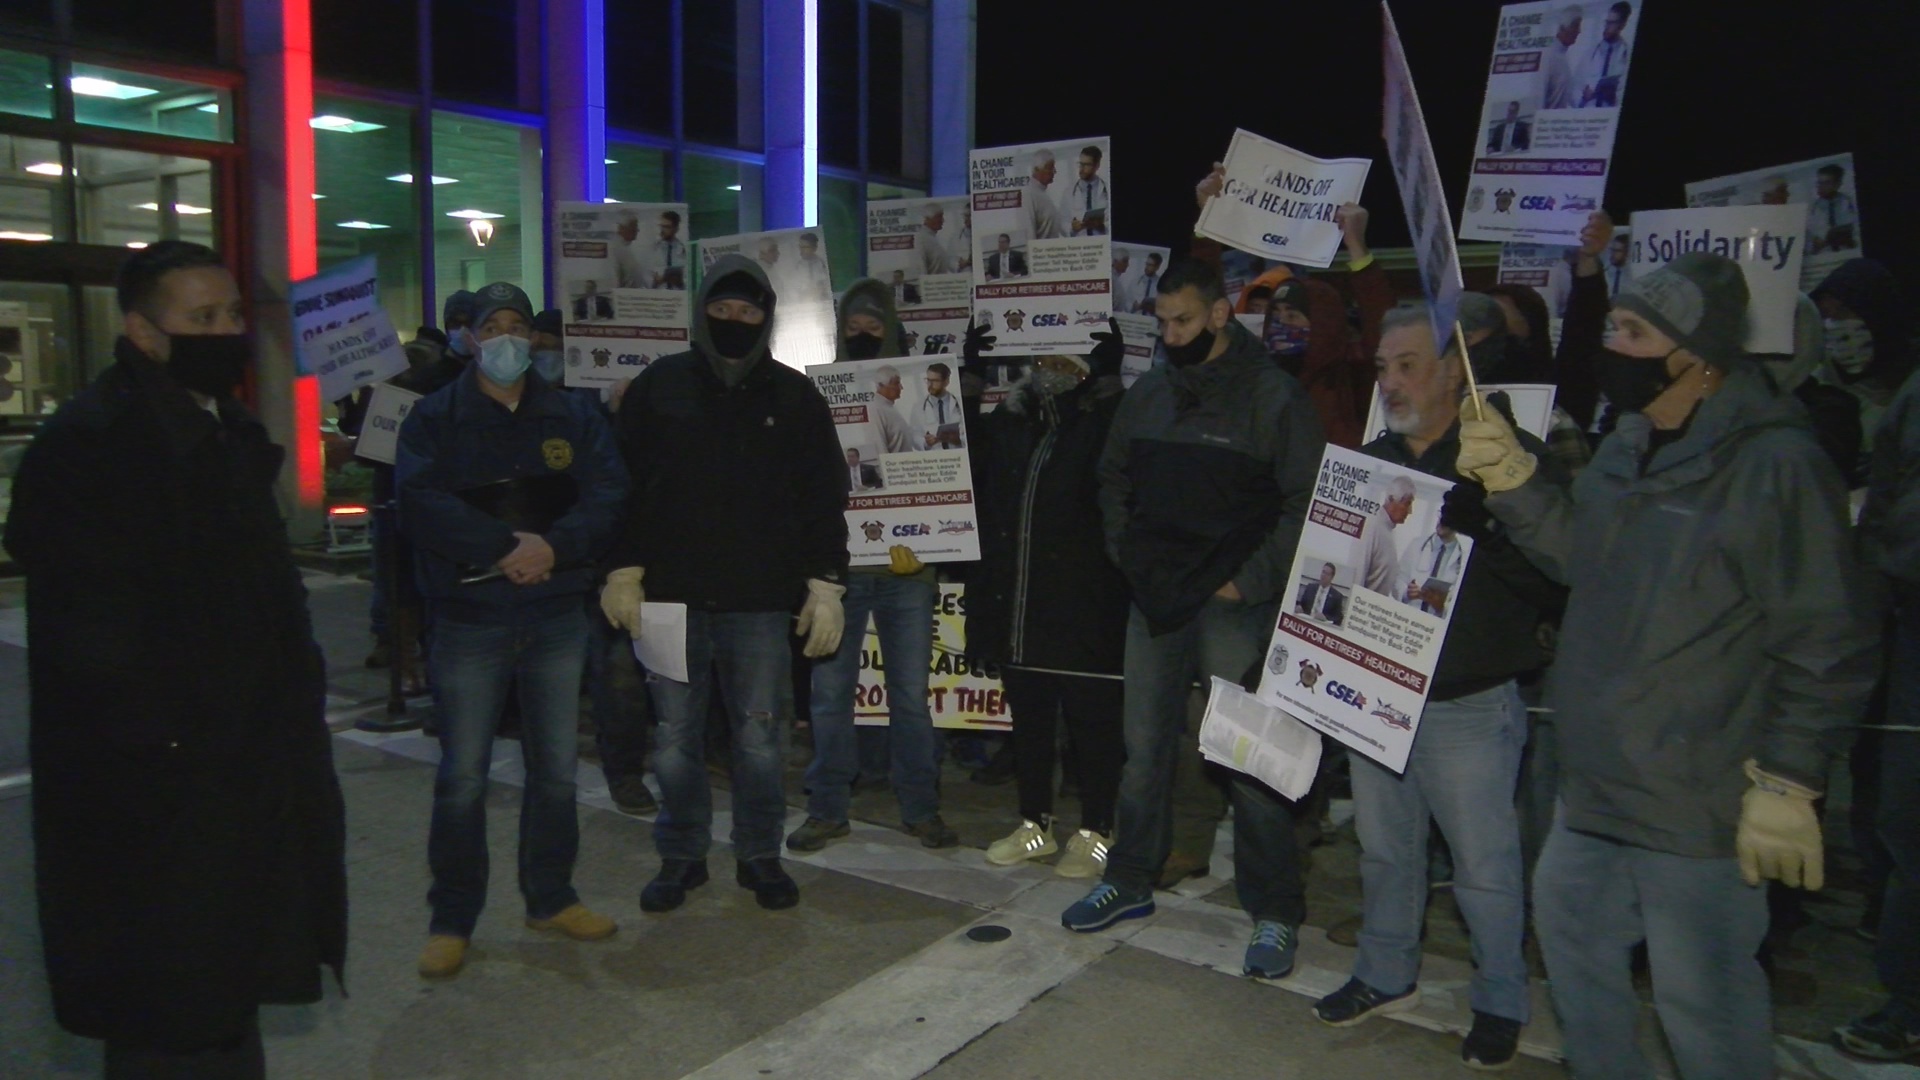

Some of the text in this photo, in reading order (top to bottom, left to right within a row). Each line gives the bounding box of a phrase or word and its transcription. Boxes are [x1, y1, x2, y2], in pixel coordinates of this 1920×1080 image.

[972, 156, 1014, 170] A CHANGE
[972, 168, 1005, 180] IN YOUR
[972, 176, 1030, 190] HEALTHCARE?
[1312, 178, 1334, 196] OFF
[1519, 194, 1556, 211] CSEA
[1262, 232, 1290, 246] CSEA
[1648, 228, 1795, 270] Solidarity
[979, 282, 1106, 296] RALLY FOR RETIREES' HEALTHCARE
[1032, 312, 1069, 328] CSEA
[616, 354, 650, 366] CSEA
[818, 372, 855, 386] CHANGE
[822, 384, 846, 395] YOUR
[825, 392, 875, 405] ALTHCARE?
[372, 414, 397, 432] OUR
[898, 458, 922, 466] retirees
[1322, 458, 1370, 484] A CHANGE
[888, 478, 918, 486] Sundquist
[1320, 470, 1356, 494] IN YOUR
[856, 498, 874, 508] FOR
[874, 496, 913, 506] RETIREES'
[914, 492, 968, 504] HEALTHCARE
[1316, 484, 1380, 516] HEALTHCARE?
[892, 522, 932, 538] CSEA
[1354, 596, 1435, 634] Our retirees have earned
[1352, 604, 1368, 616] their
[1404, 626, 1424, 640] Leave
[1425, 634, 1431, 644] it
[1347, 621, 1378, 640] Sundquist
[1378, 635, 1386, 644] to
[1388, 639, 1403, 652] Back
[1370, 621, 1382, 632] Tell
[1382, 626, 1404, 642] Mayor
[1404, 636, 1424, 650] Eddie
[1282, 617, 1423, 690] RALLY FOR RETIREES' HEALTHCARE
[953, 686, 1006, 716] THE
[1326, 680, 1368, 711] CSEA
